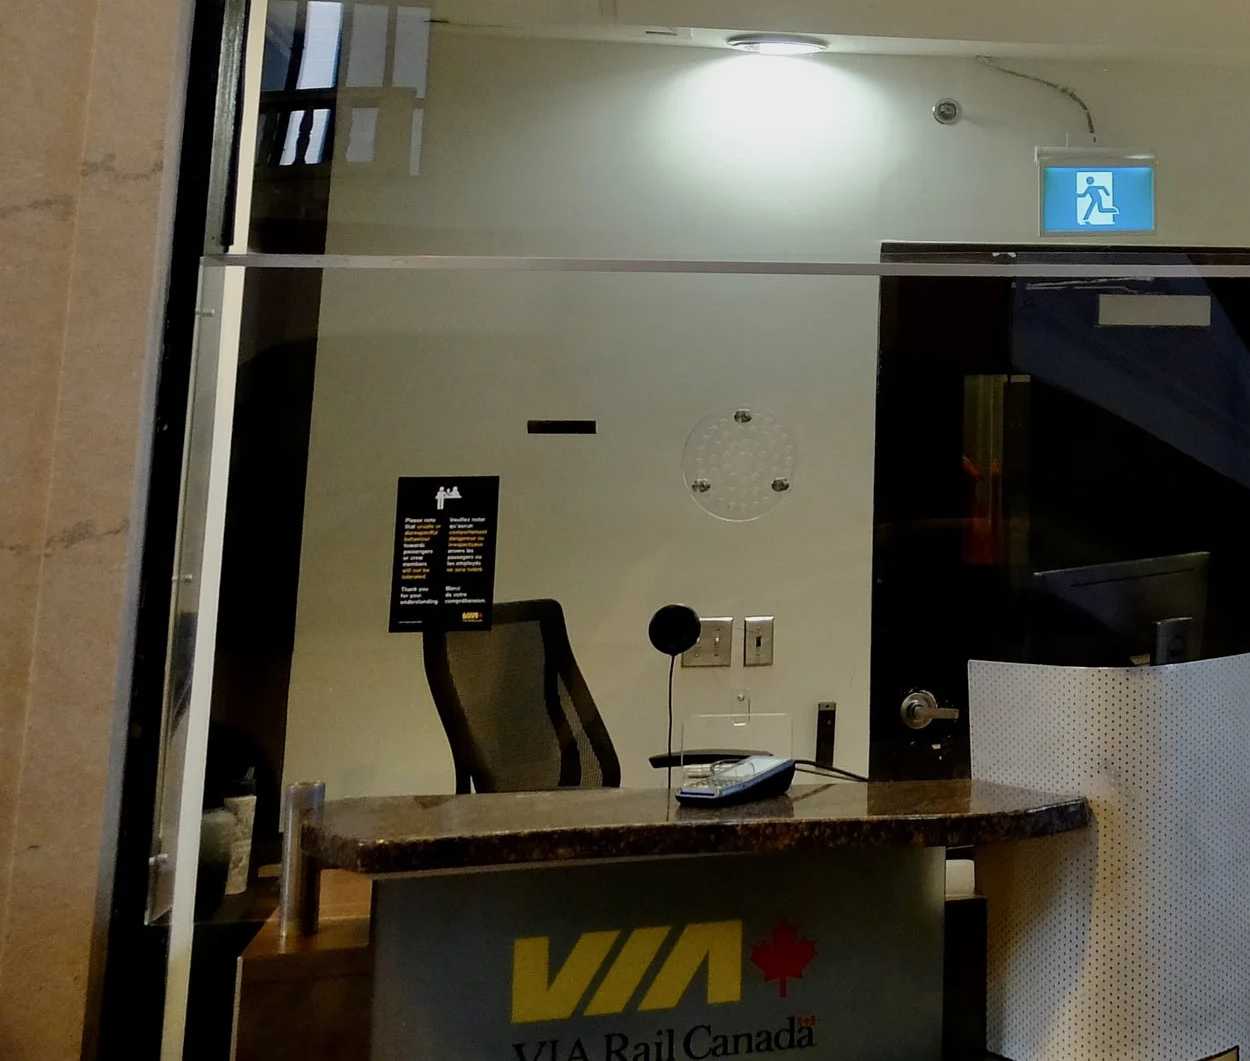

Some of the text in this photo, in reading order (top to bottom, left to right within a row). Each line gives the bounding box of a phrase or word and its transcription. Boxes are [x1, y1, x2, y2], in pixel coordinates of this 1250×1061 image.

[511, 919, 742, 1024] VIA
[604, 1029, 675, 1061] Rail
[683, 1016, 817, 1060] Canada
